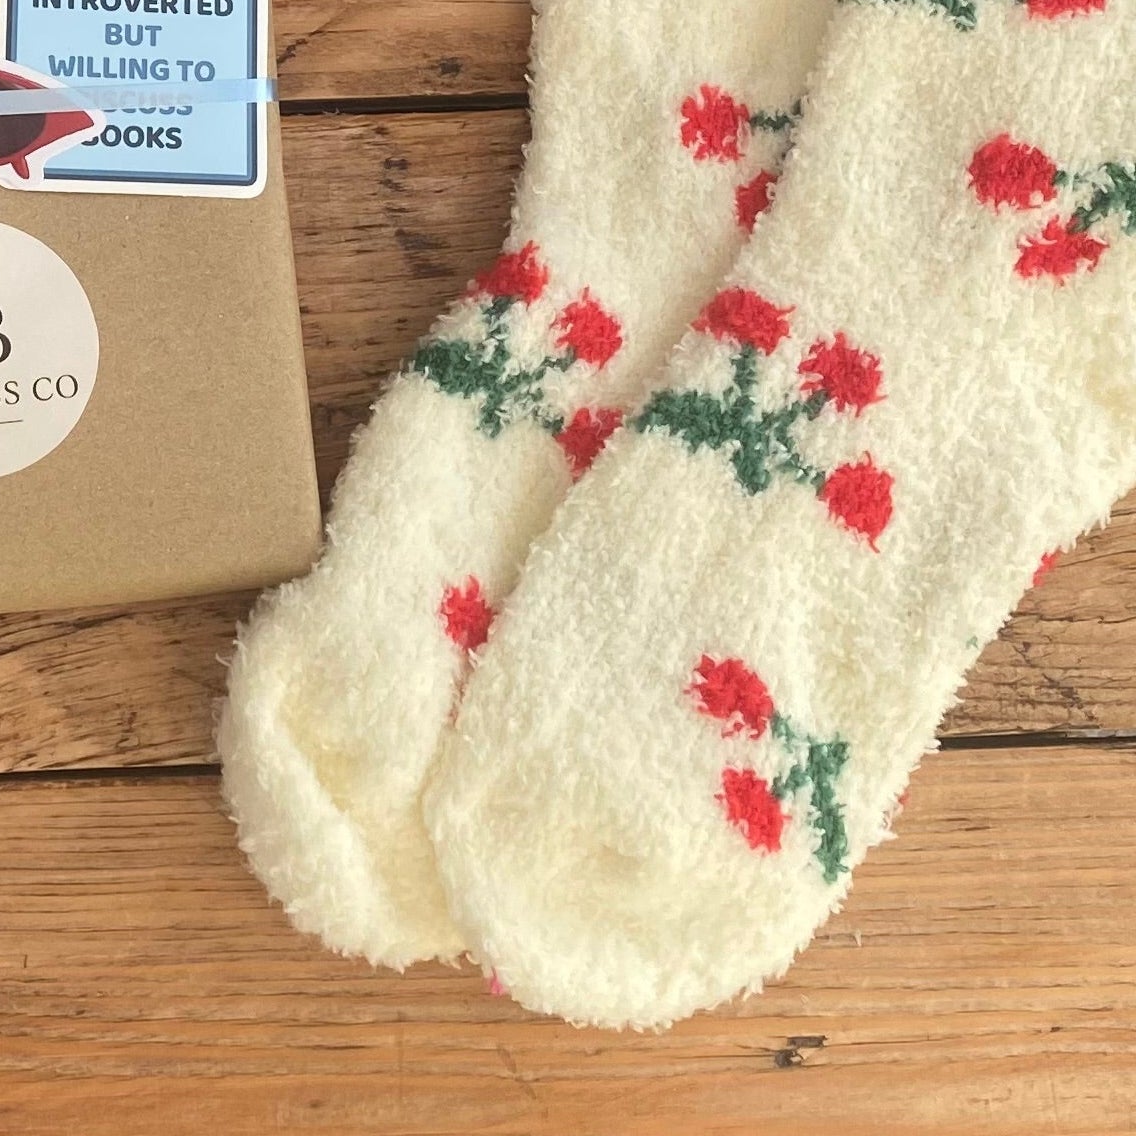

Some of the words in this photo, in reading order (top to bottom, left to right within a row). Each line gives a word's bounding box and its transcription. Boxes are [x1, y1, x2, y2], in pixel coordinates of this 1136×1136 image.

[104, 23, 162, 47] BUT
[48, 54, 170, 81] WILLING
[176, 60, 215, 82] TO
[32, 374, 79, 402] CO
